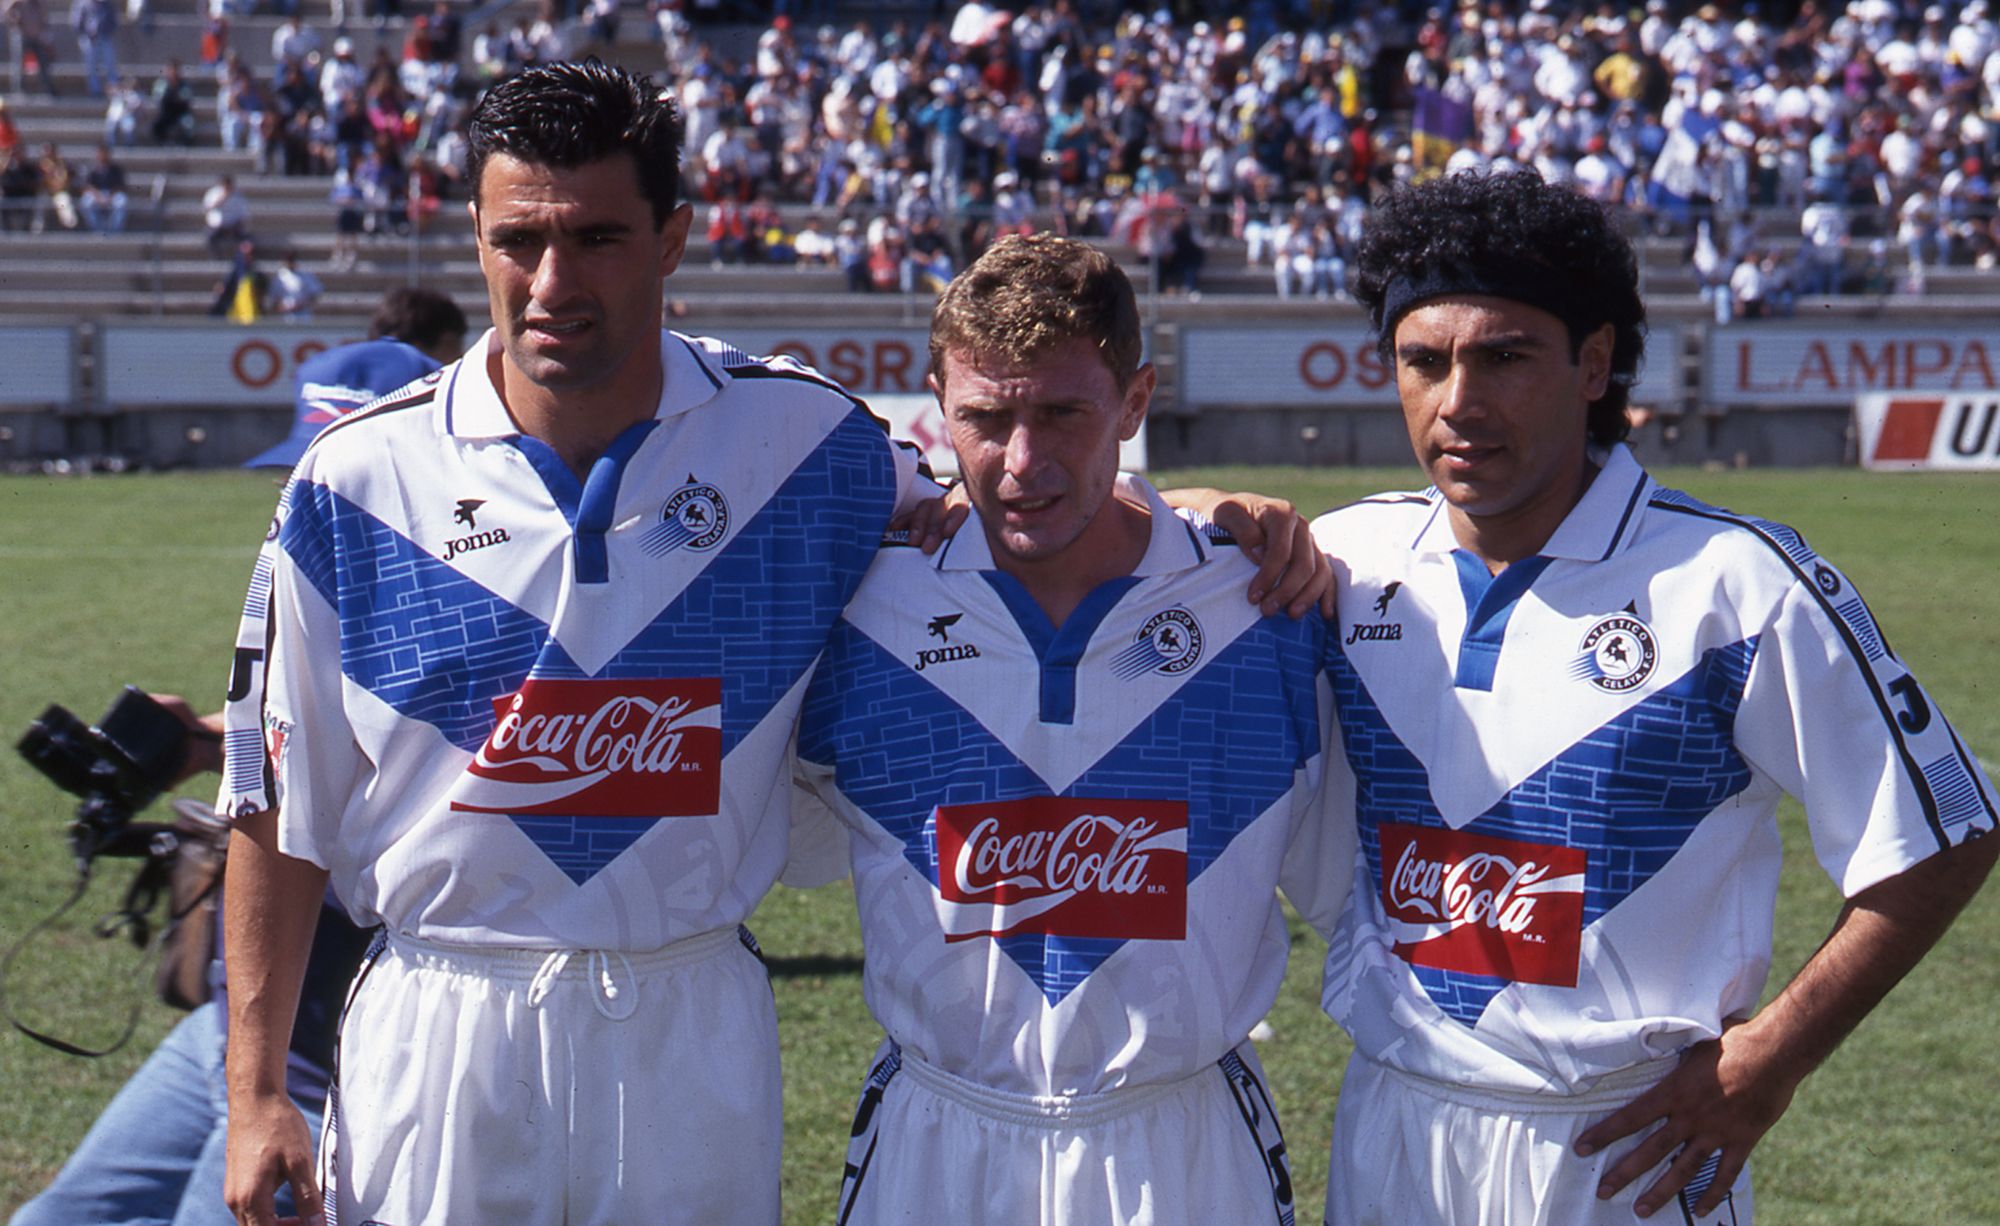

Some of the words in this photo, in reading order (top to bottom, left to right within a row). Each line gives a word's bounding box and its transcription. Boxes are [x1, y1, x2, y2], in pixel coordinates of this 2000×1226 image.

[1737, 338, 1998, 391] LAMPA
[666, 487, 716, 516] ATLETICO
[442, 527, 511, 561] Joma
[1145, 611, 1192, 634] ATLETICO
[1345, 623, 1403, 645] Joma
[1587, 620, 1649, 646] ATLETICO
[914, 643, 981, 671] Joma
[955, 814, 1158, 894] Coca-Cola
[1147, 885, 1168, 894] M.R.
[1389, 840, 1550, 933] Coca-Cola
[1522, 932, 1547, 944] M.R.
